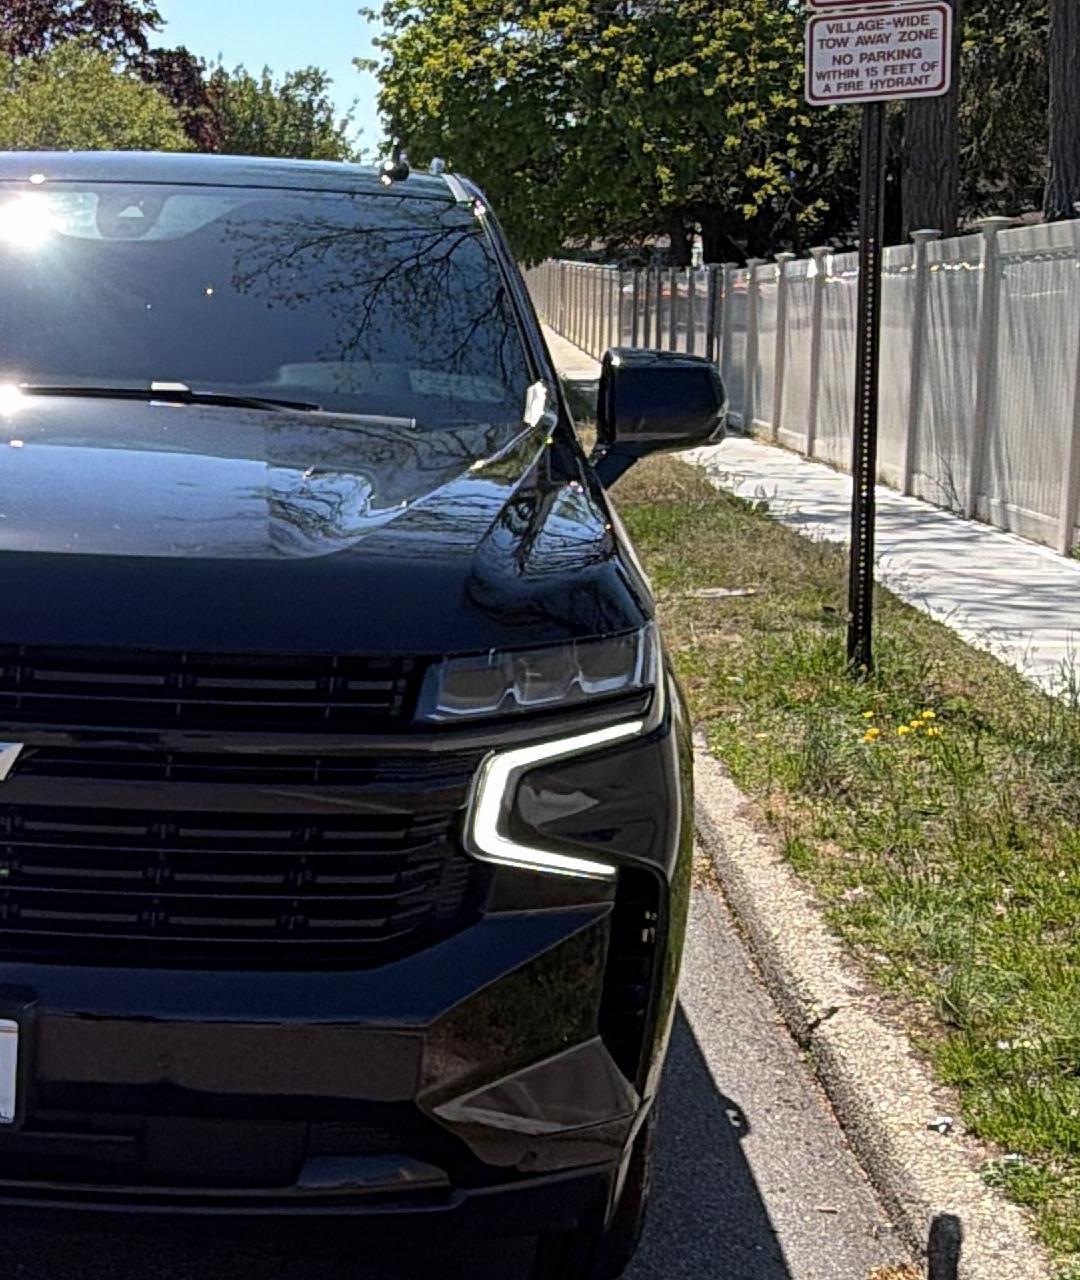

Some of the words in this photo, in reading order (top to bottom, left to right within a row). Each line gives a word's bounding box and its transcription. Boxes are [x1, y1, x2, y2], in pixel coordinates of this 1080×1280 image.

[826, 14, 930, 34] VILLAGE-WIDE
[818, 37, 849, 50] TOW
[854, 32, 892, 47] AWAY
[898, 28, 939, 43] ZONE
[832, 53, 854, 66] NO
[859, 47, 923, 64] PARKING
[815, 69, 860, 82] WITHIN
[865, 66, 878, 78] 15
[883, 62, 916, 77] FEET
[920, 60, 939, 73] OF
[822, 82, 832, 94] A
[836, 80, 864, 92] FIRE
[869, 74, 931, 91] HYDRANT
